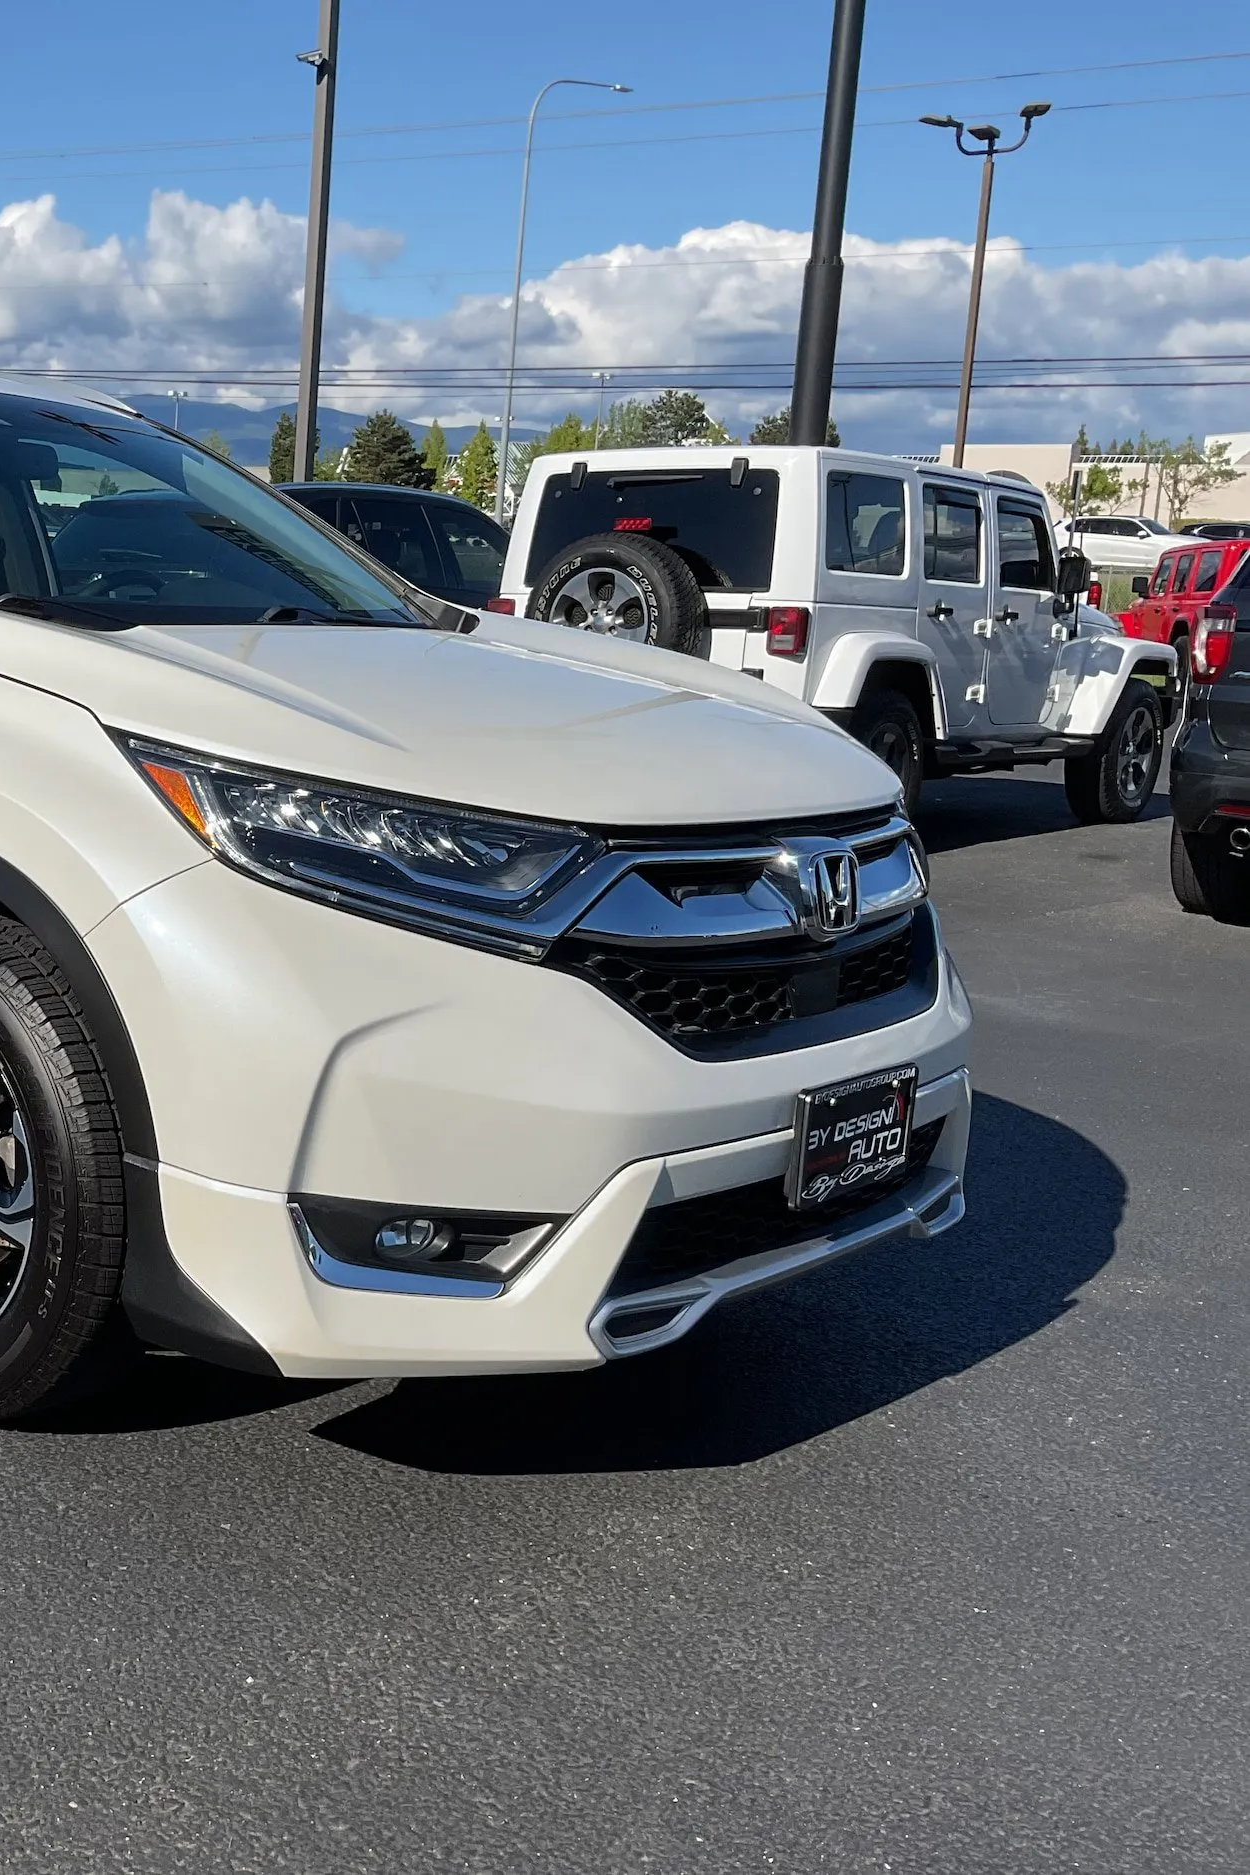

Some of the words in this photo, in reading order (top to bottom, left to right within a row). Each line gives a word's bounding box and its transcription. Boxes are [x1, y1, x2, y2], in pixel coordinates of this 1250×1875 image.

[807, 1126, 831, 1151] BY
[834, 1105, 895, 1142] DESIGN
[848, 1127, 902, 1163] AUTO
[802, 1175, 838, 1202] By
[839, 1155, 907, 1185] Design
